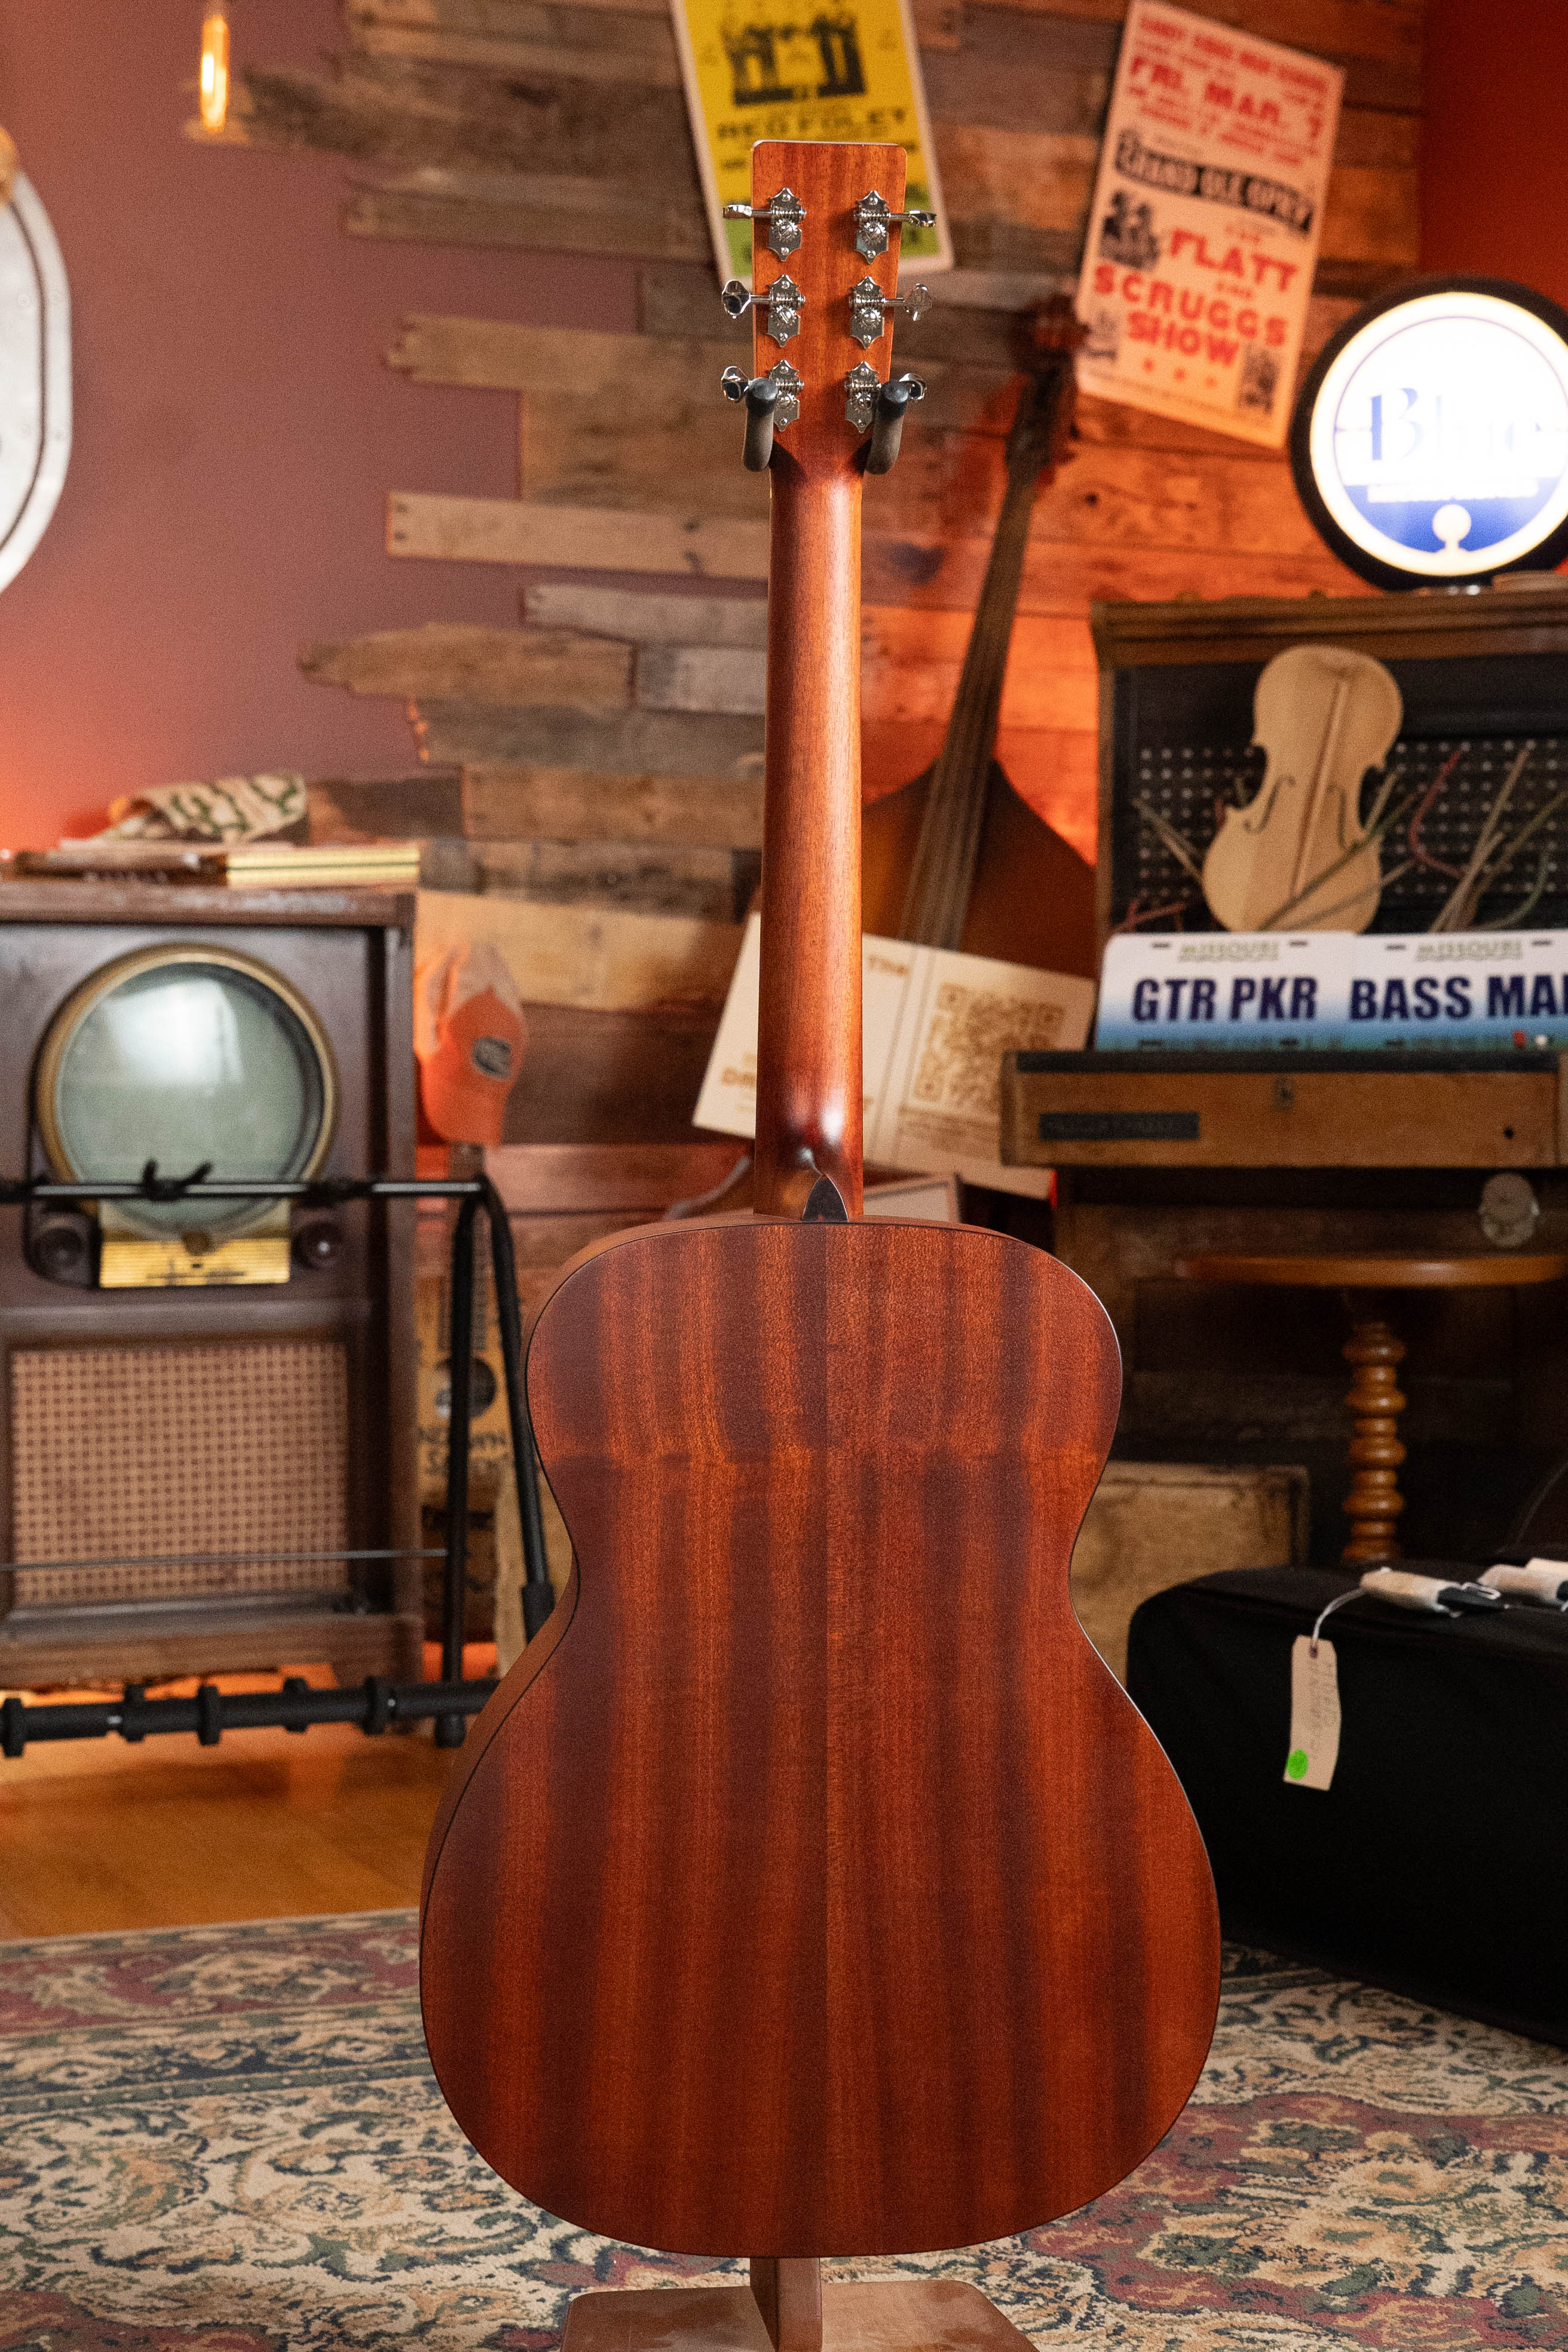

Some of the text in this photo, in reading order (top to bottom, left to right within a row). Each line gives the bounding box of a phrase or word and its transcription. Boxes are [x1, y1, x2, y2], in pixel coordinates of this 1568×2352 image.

[1169, 229, 1298, 292] FLATT
[1094, 265, 1287, 347] SCRUGGS
[1127, 310, 1239, 366] SHOW
[1180, 941, 1279, 961] MISSOURI
[1417, 939, 1522, 961] MISSOURI
[1132, 976, 1318, 1022] GTR PKR
[1349, 976, 1472, 1021] BASS
